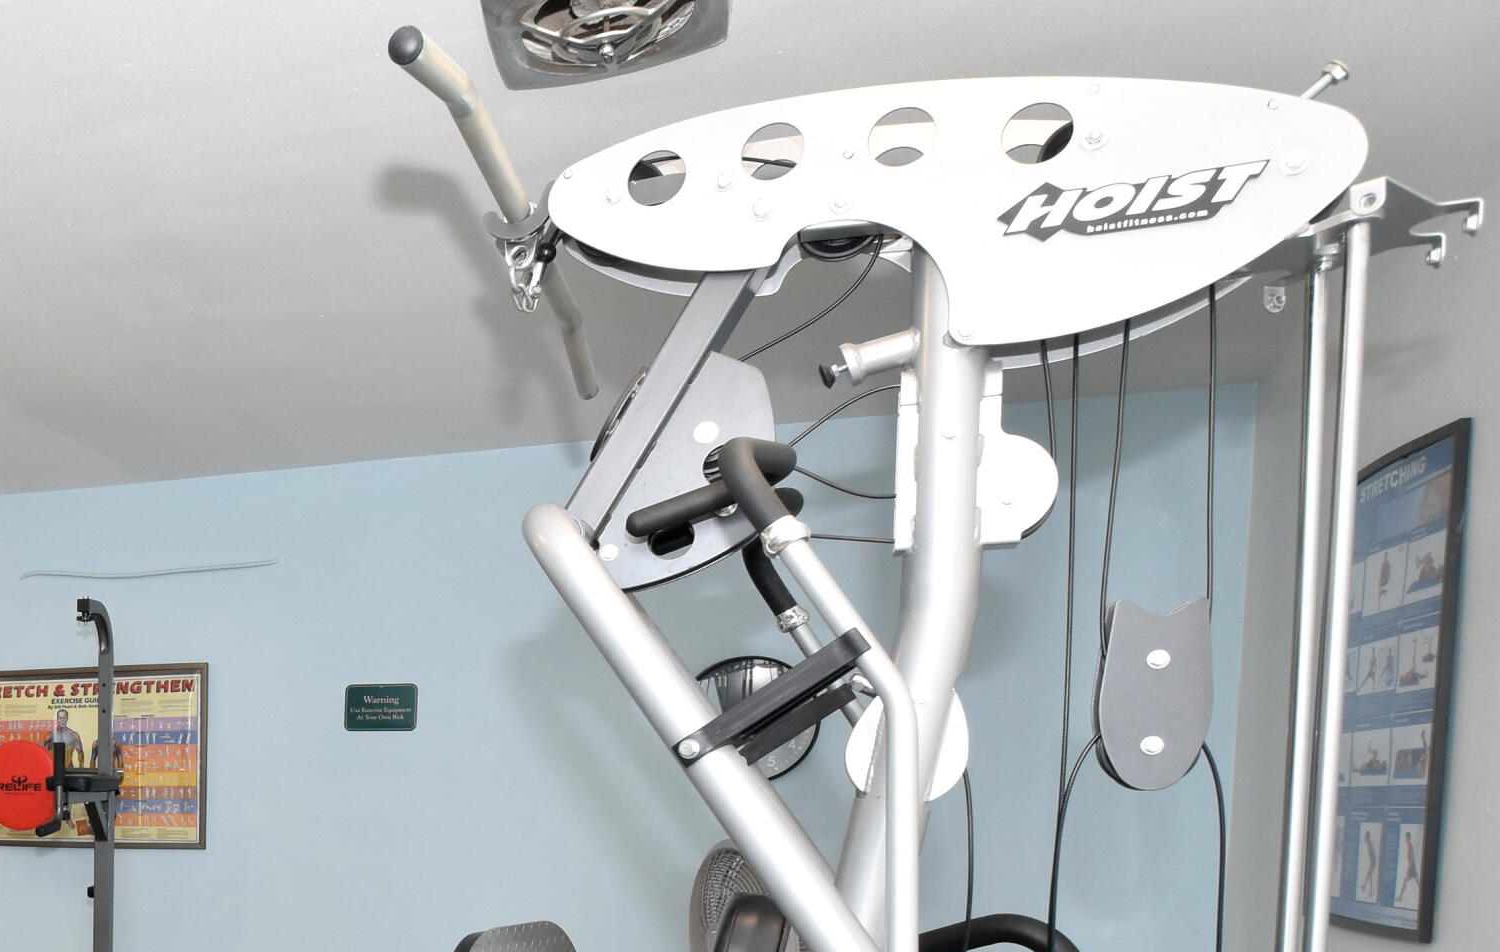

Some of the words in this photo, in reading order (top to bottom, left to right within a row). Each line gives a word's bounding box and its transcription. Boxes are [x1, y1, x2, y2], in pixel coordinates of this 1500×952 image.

[1003, 159, 1270, 236] HOIST
[1086, 210, 1208, 233] hoistfitness.com
[1360, 455, 1427, 504] STRETCHING
[53, 684, 66, 697] &
[70, 679, 195, 696] STRNGTHEN
[363, 695, 400, 705] Warning
[767, 755, 776, 767] 5
